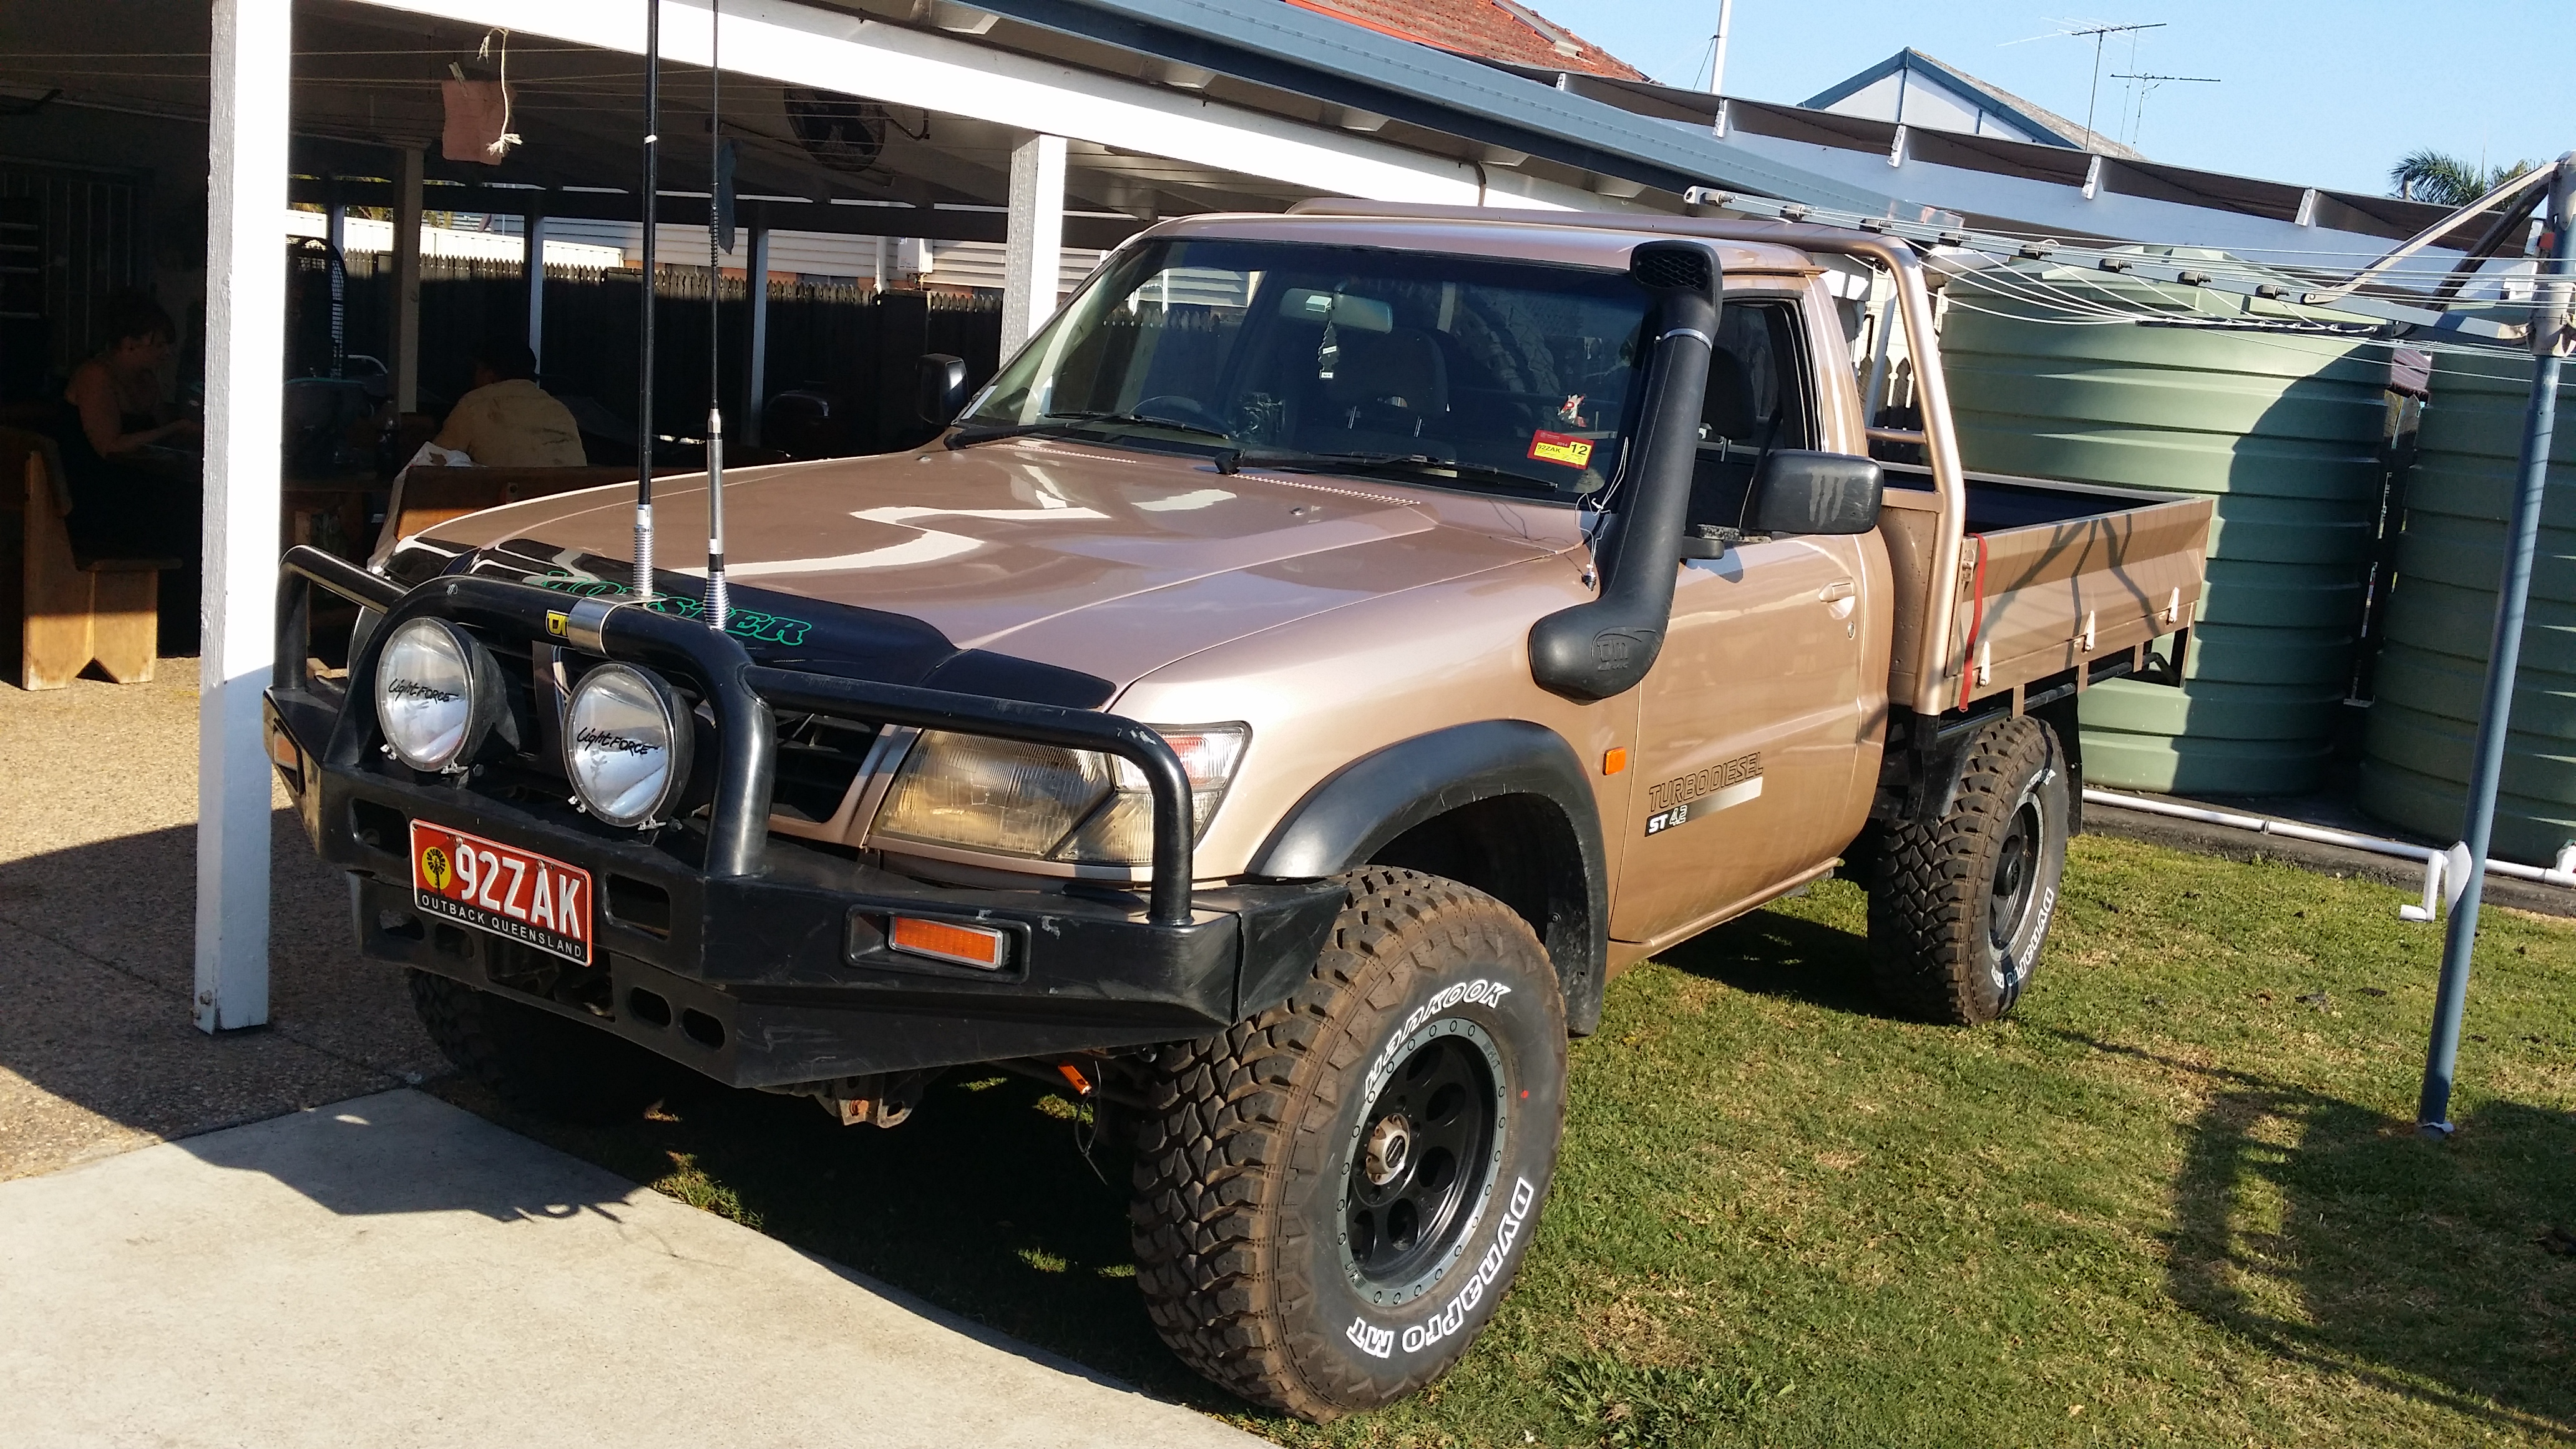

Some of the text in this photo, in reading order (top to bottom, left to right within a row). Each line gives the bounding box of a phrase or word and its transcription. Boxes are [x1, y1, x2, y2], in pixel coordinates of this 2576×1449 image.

[1538, 444, 1561, 454] 92ZAK
[1571, 443, 1588, 456] 12
[525, 570, 812, 646] MOSER
[1649, 751, 1764, 812] TURBO DIESEL
[1648, 814, 1669, 834] ST
[456, 844, 581, 939] 92ZAK
[421, 894, 582, 958] OUTBACK QUEENSLAND
[1345, 1315, 1395, 1359] MT
